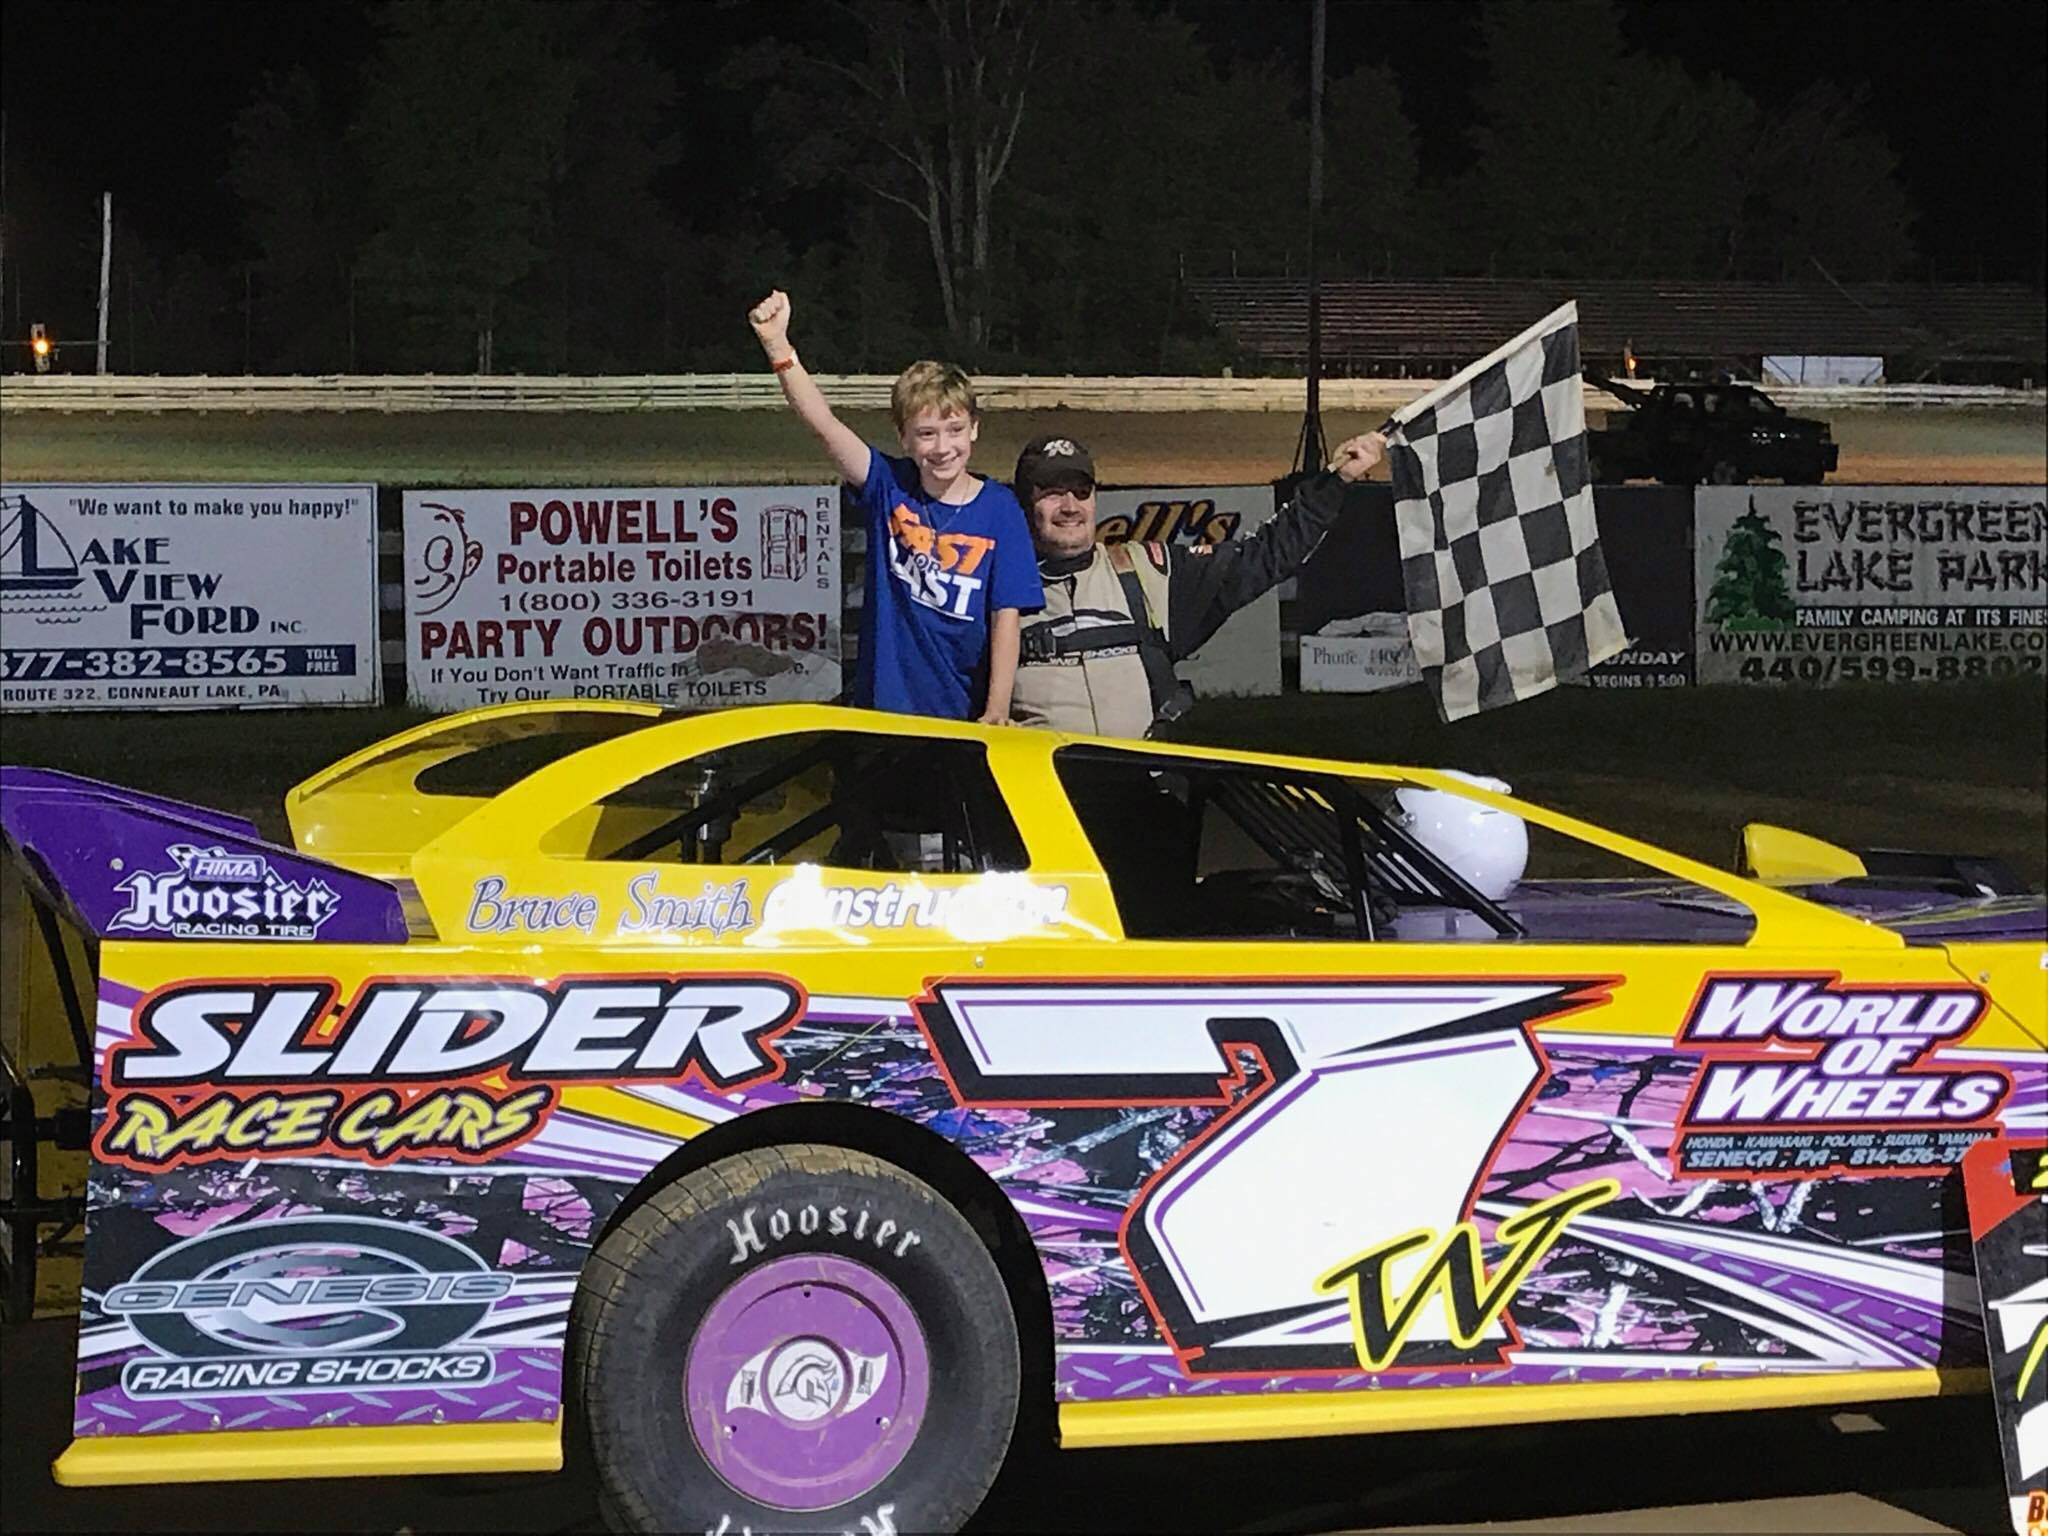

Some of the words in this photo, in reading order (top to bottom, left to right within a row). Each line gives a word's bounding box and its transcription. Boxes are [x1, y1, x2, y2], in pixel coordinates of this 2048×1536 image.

[113, 500, 162, 516] want
[168, 499, 189, 516] to
[194, 498, 243, 516] make
[250, 502, 283, 519] you
[510, 497, 739, 546] POWELL'S
[815, 497, 831, 590] RENTALS
[497, 552, 636, 584] Portable
[647, 550, 753, 582] Toilets
[1796, 549, 1914, 592] LAKE
[1936, 549, 2048, 592] PARK
[94, 569, 223, 604] VIEW
[499, 592, 601, 615] 1(800)
[611, 590, 755, 611] 336-3191
[130, 604, 260, 640] FORD
[1796, 609, 1854, 627] FAMILY
[1861, 608, 1941, 626] CAMPING
[1945, 609, 1967, 626] AT
[1976, 609, 2001, 626] ITS
[306, 649, 339, 661] TOLL
[420, 617, 563, 660] PARTY
[306, 661, 340, 674] FREE
[431, 668, 443, 684] If
[449, 668, 488, 684] You
[494, 666, 545, 683] Don't
[550, 665, 600, 681] Want
[605, 663, 665, 680] Traffic
[3, 688, 57, 702] ROUTE
[107, 686, 200, 700] CONNEAUT
[477, 688, 509, 704] Try
[514, 687, 550, 701] Our
[573, 683, 679, 699] PORTABLE
[686, 680, 768, 698] TOILETS
[120, 868, 336, 928] Hoosier
[466, 874, 599, 934] Bruce
[618, 871, 756, 934] Smith
[177, 923, 260, 937] RACING
[266, 923, 314, 937] TIRE
[1693, 982, 1979, 1037] WORLD
[116, 980, 795, 1086] SLIDER
[1821, 1037, 1927, 1076] OF
[1694, 1066, 2001, 1121] WHEELS
[110, 1093, 336, 1158] RACE
[337, 1088, 546, 1155] CARS
[1686, 1136, 1736, 1150] HONDA
[1744, 1135, 1813, 1149] KAWASAKI
[1821, 1134, 1875, 1148] POLARIS
[724, 1202, 923, 1264] Hoosier
[103, 1273, 514, 1312] GENESIS
[130, 1362, 299, 1391] RACING
[305, 1354, 485, 1386] SHOCKS
